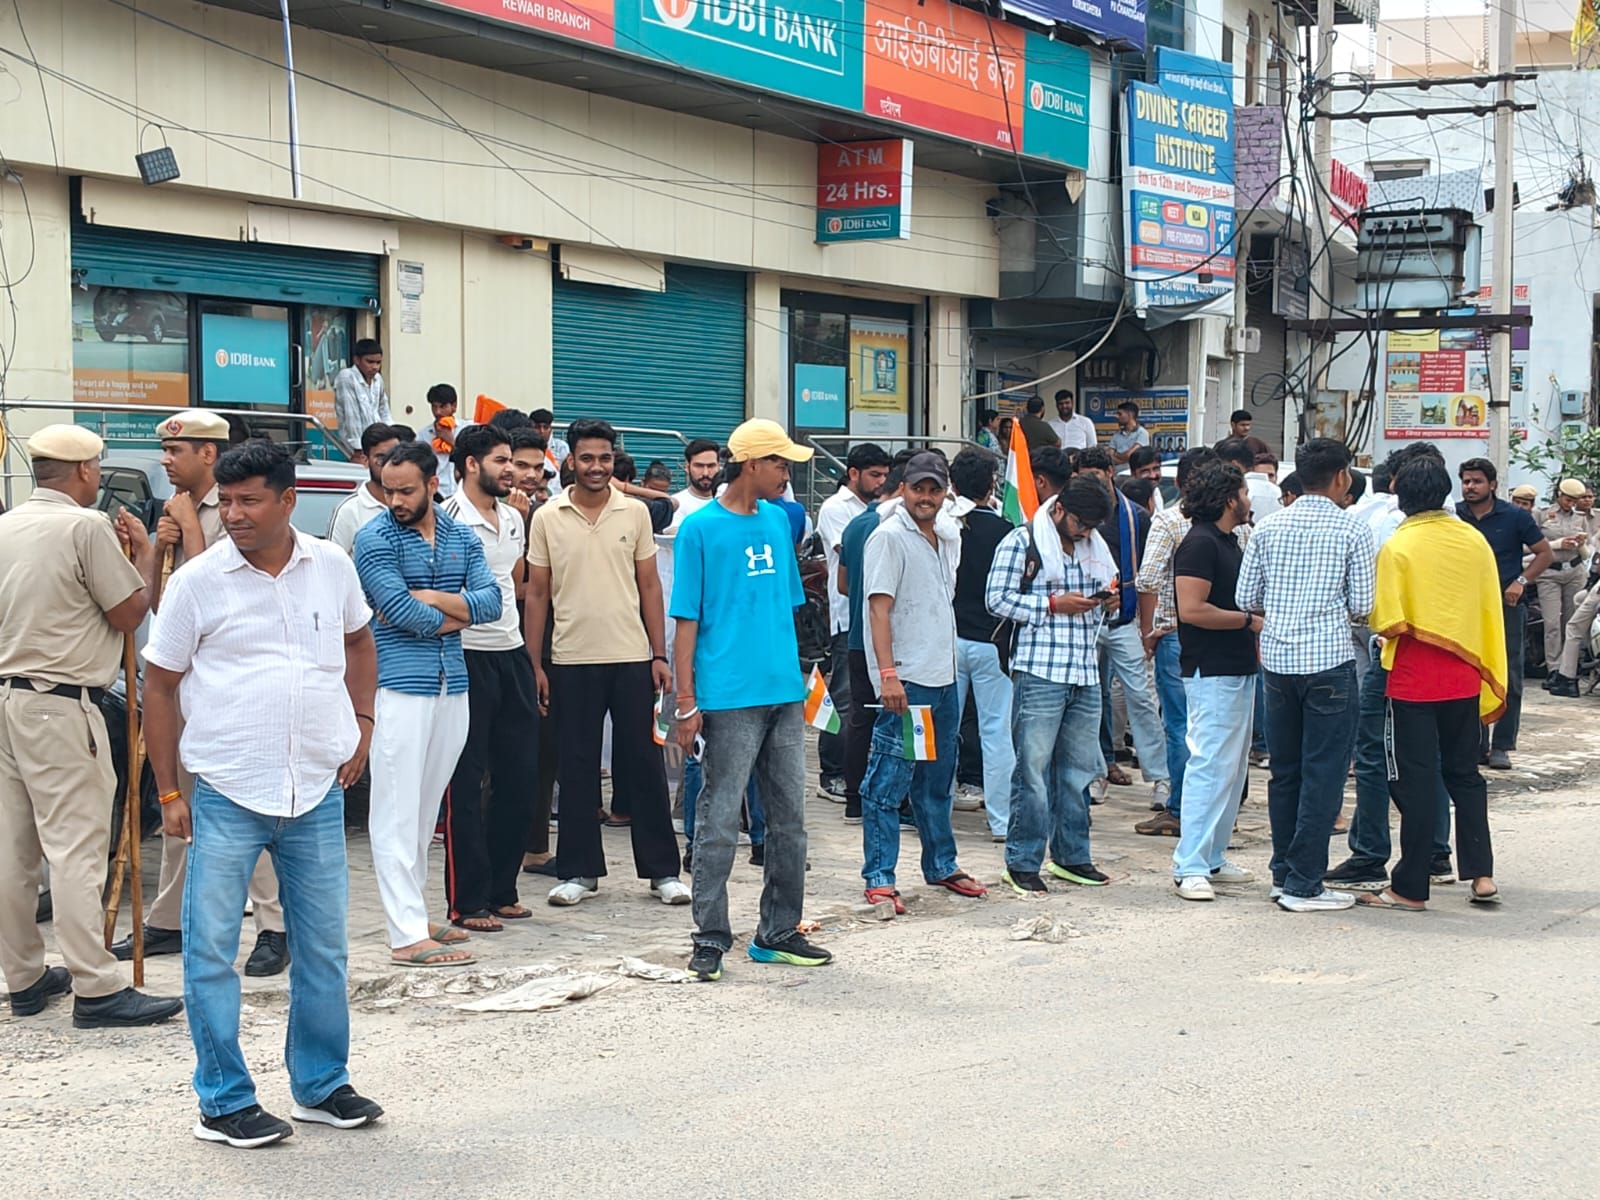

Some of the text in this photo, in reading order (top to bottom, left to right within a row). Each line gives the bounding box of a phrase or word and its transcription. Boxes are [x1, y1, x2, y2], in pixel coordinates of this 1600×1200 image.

[502, 0, 591, 31] REWARI BRANCH
[774, 5, 838, 57] BANK
[874, 17, 980, 90] आईडीबीआई
[1044, 93, 1084, 117] IDBI BANK
[1135, 89, 1228, 143] DIVINE CAREER
[996, 130, 1011, 144] ATM
[837, 148, 883, 167] ATM
[1155, 133, 1216, 174] INSTITUTE
[826, 181, 893, 202] 24 Hrs.
[1174, 179, 1185, 192] and
[843, 219, 888, 230] IDBI BANK
[230, 352, 276, 368] IDBI BANK
